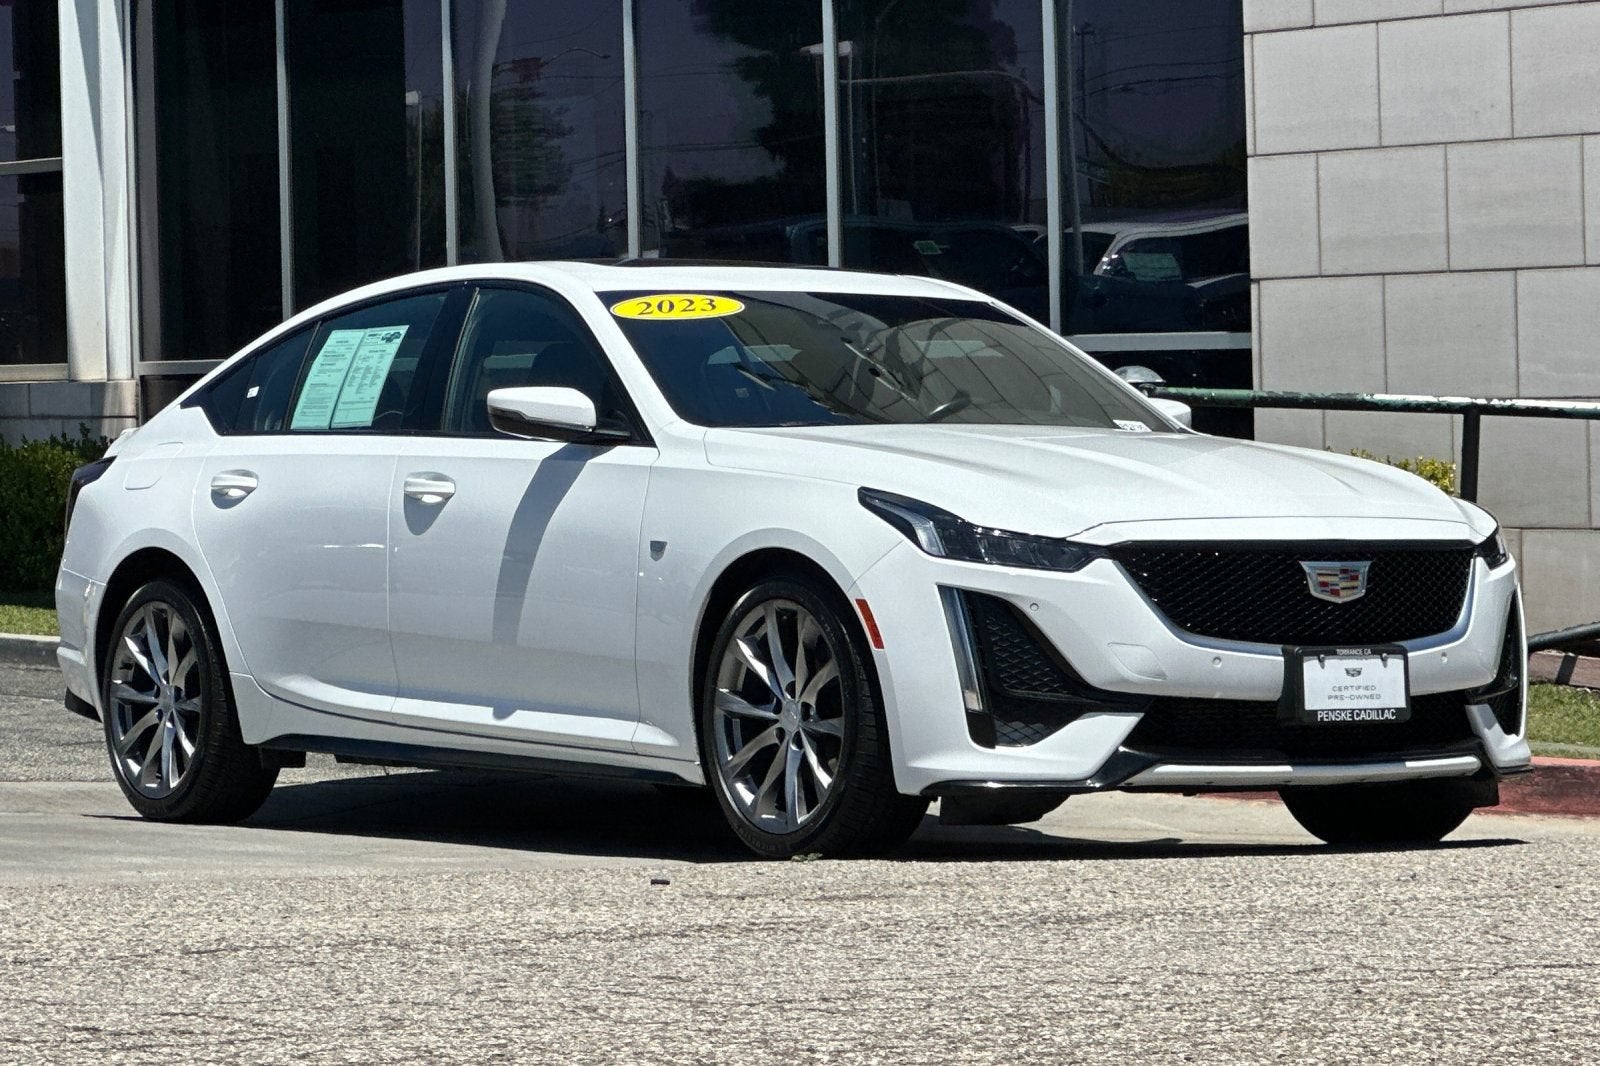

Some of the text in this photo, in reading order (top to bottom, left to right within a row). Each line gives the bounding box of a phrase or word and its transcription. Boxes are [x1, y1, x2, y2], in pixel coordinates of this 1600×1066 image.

[636, 298, 717, 316] 2023
[1317, 709, 1396, 722] PENSKE CADILLAC
